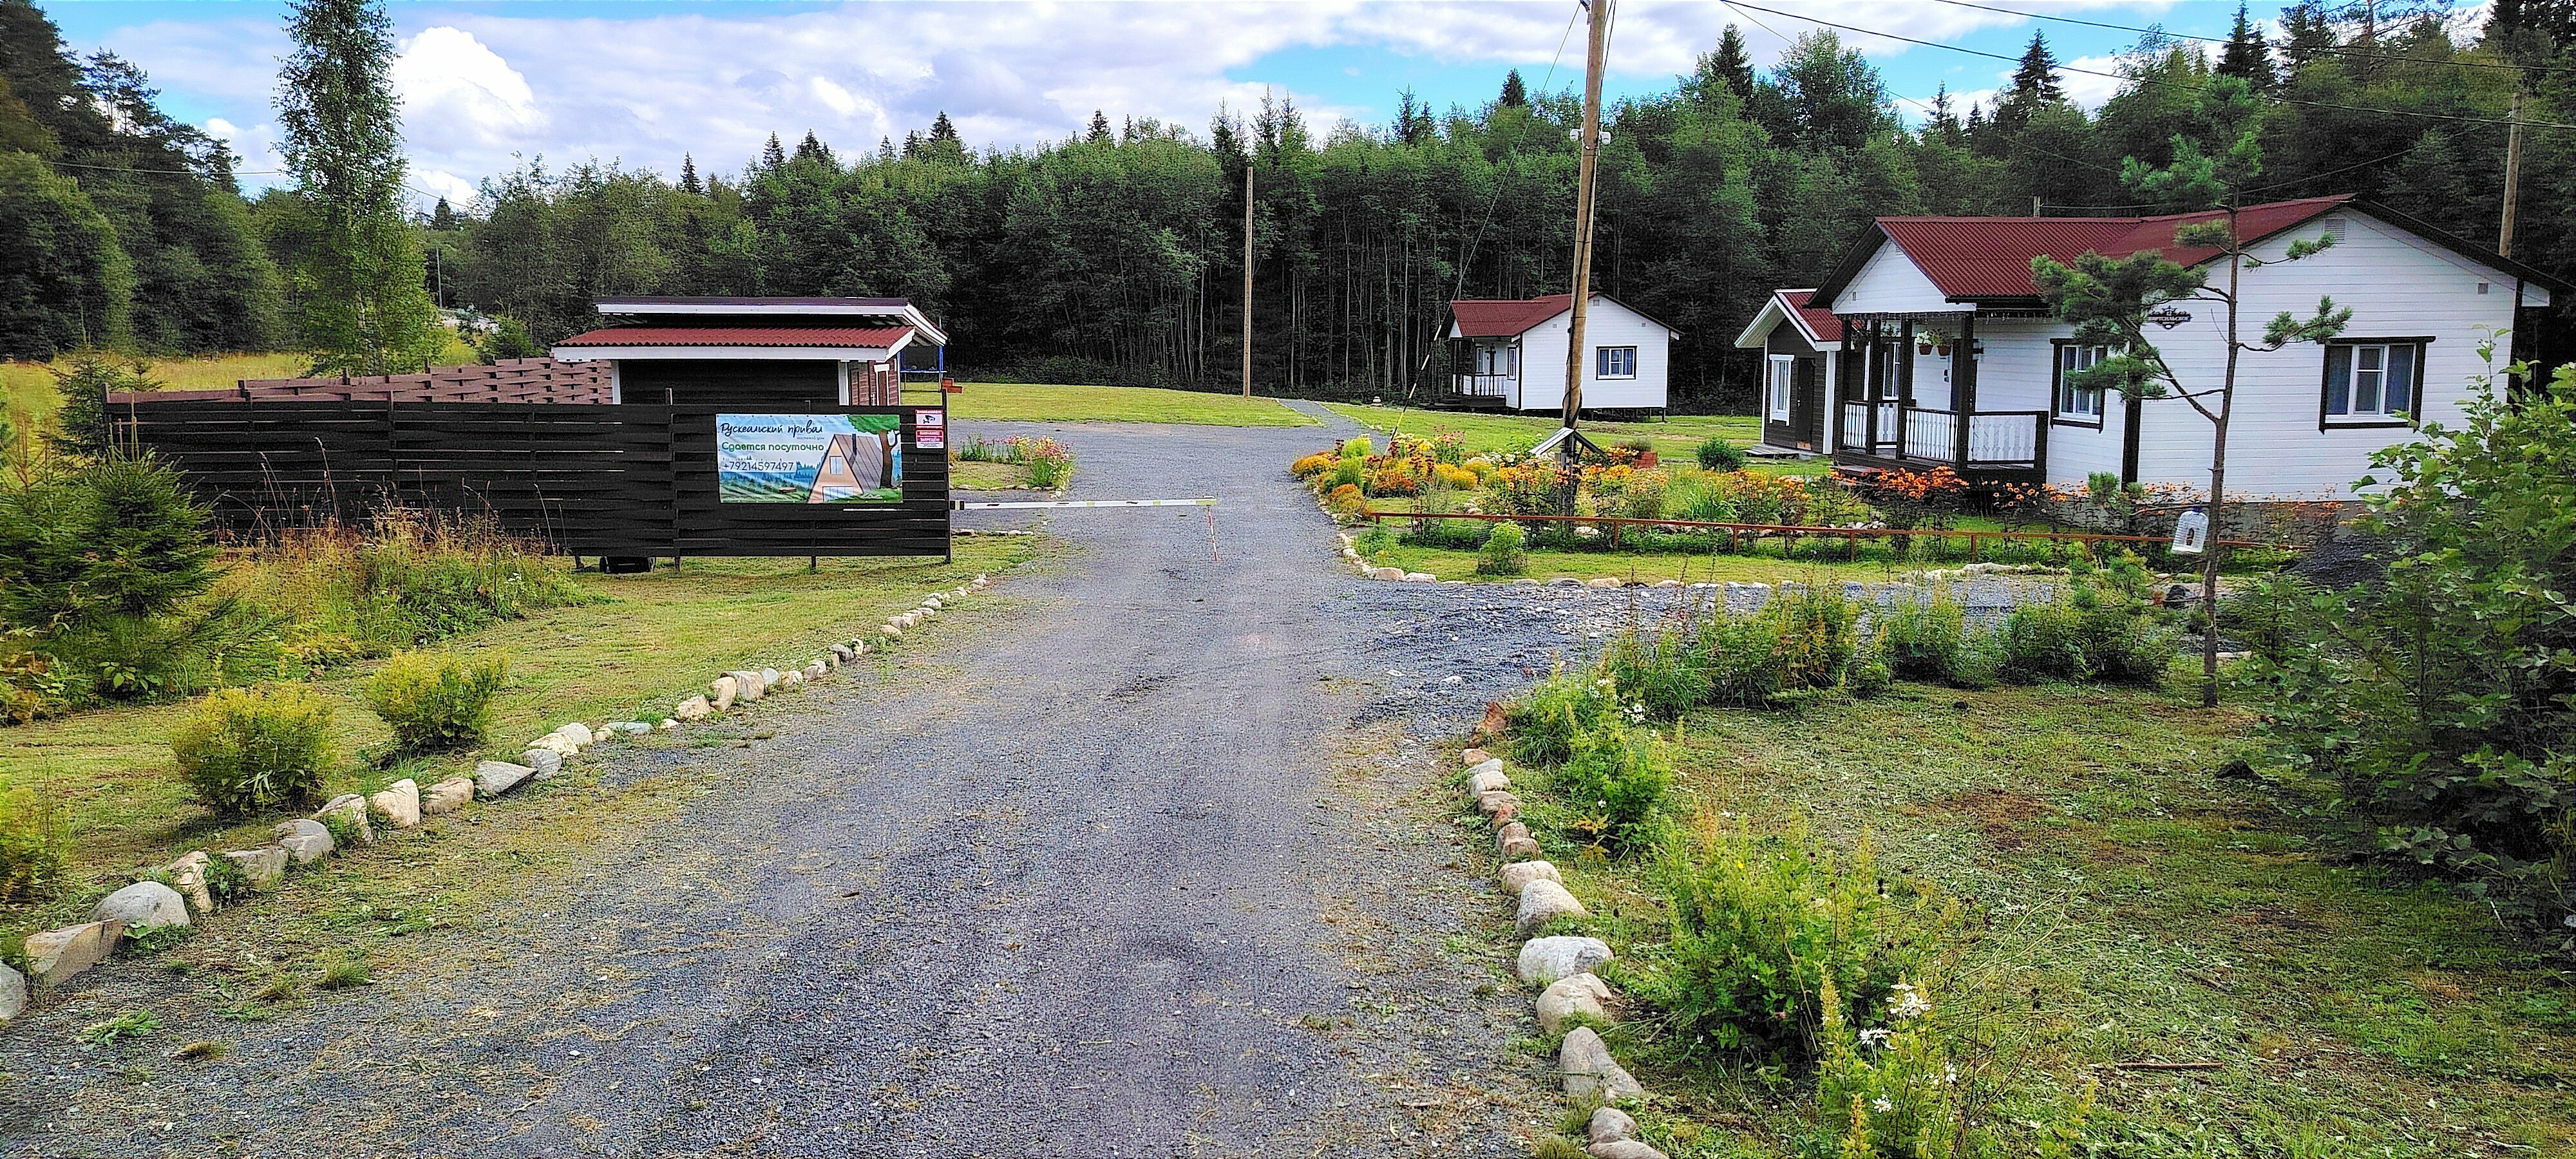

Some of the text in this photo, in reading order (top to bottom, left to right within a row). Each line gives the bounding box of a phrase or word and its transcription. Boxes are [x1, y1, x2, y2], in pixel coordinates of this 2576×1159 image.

[720, 419, 823, 437] Рускеальский привал
[721, 441, 824, 453] Сдается посуточно
[723, 461, 794, 471] +79214597497
